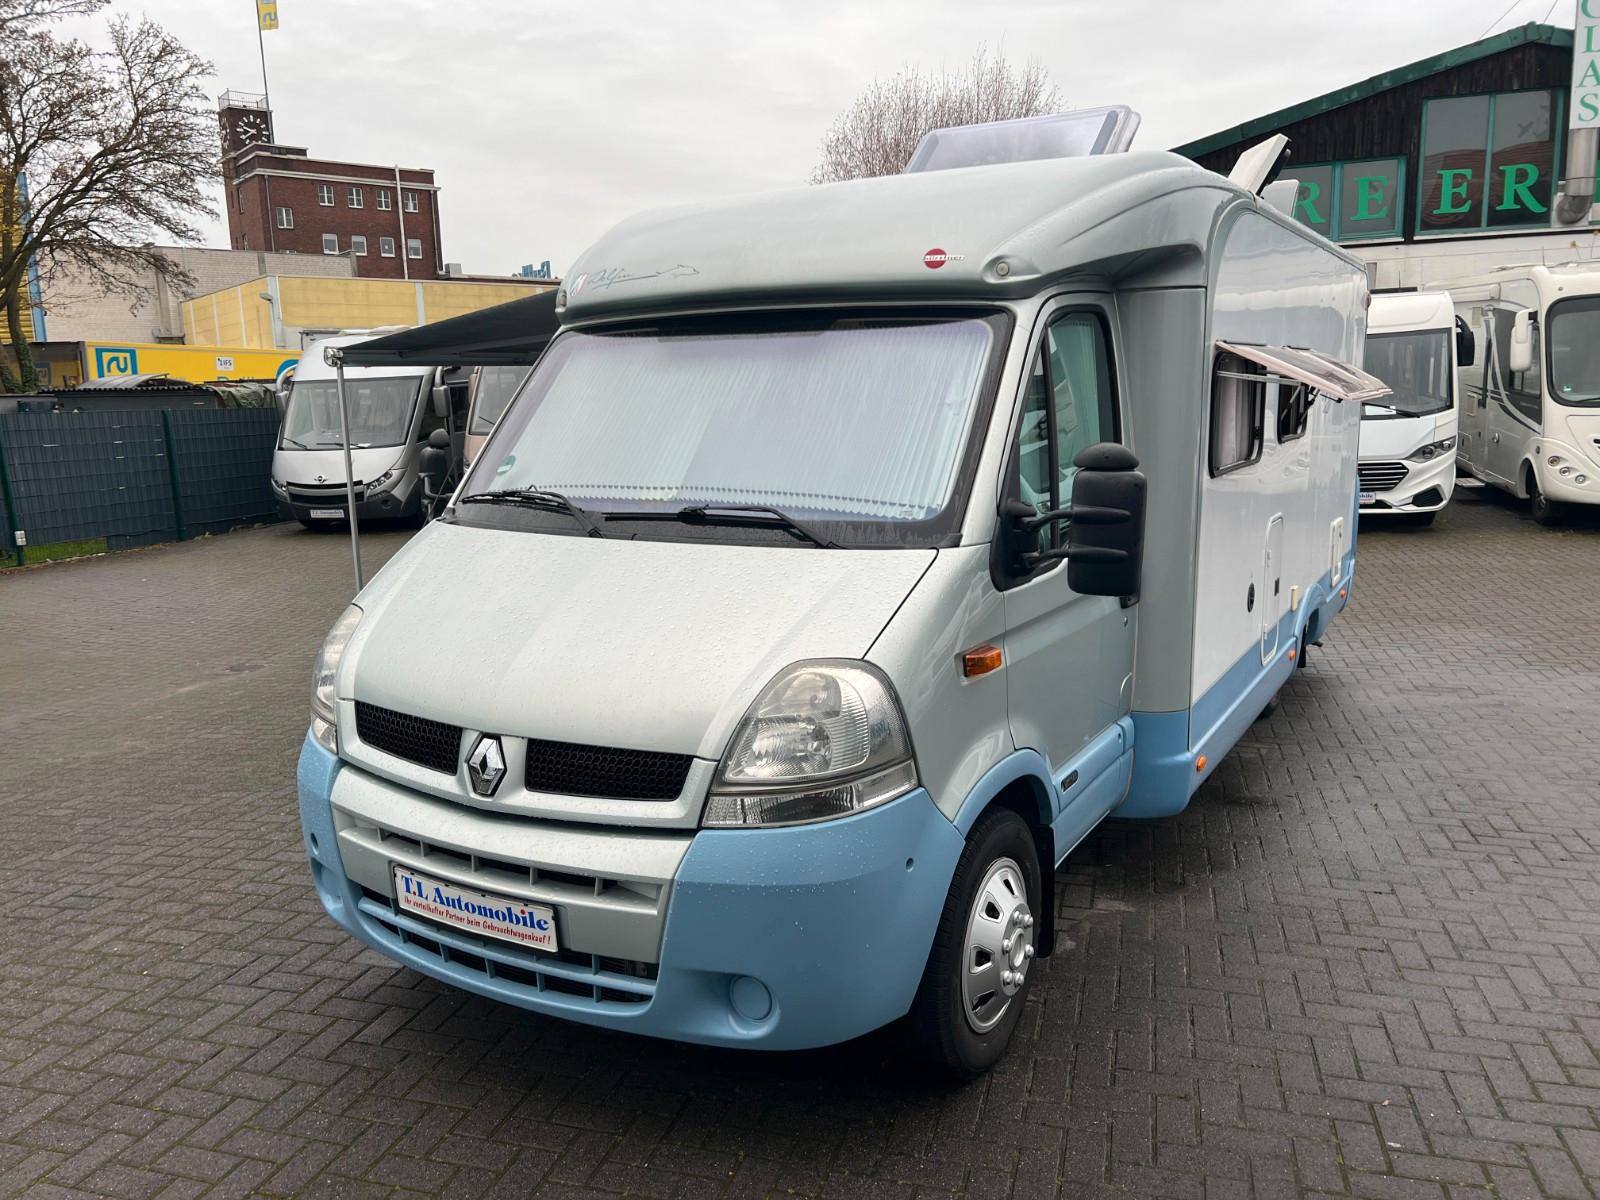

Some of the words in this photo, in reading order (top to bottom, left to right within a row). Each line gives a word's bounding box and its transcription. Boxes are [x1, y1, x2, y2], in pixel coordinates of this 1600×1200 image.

[404, 895, 412, 905] Ihr
[413, 900, 444, 918] vorteilhafter
[445, 909, 465, 924] Partner
[467, 916, 481, 928] beim
[433, 887, 549, 931] Automobile
